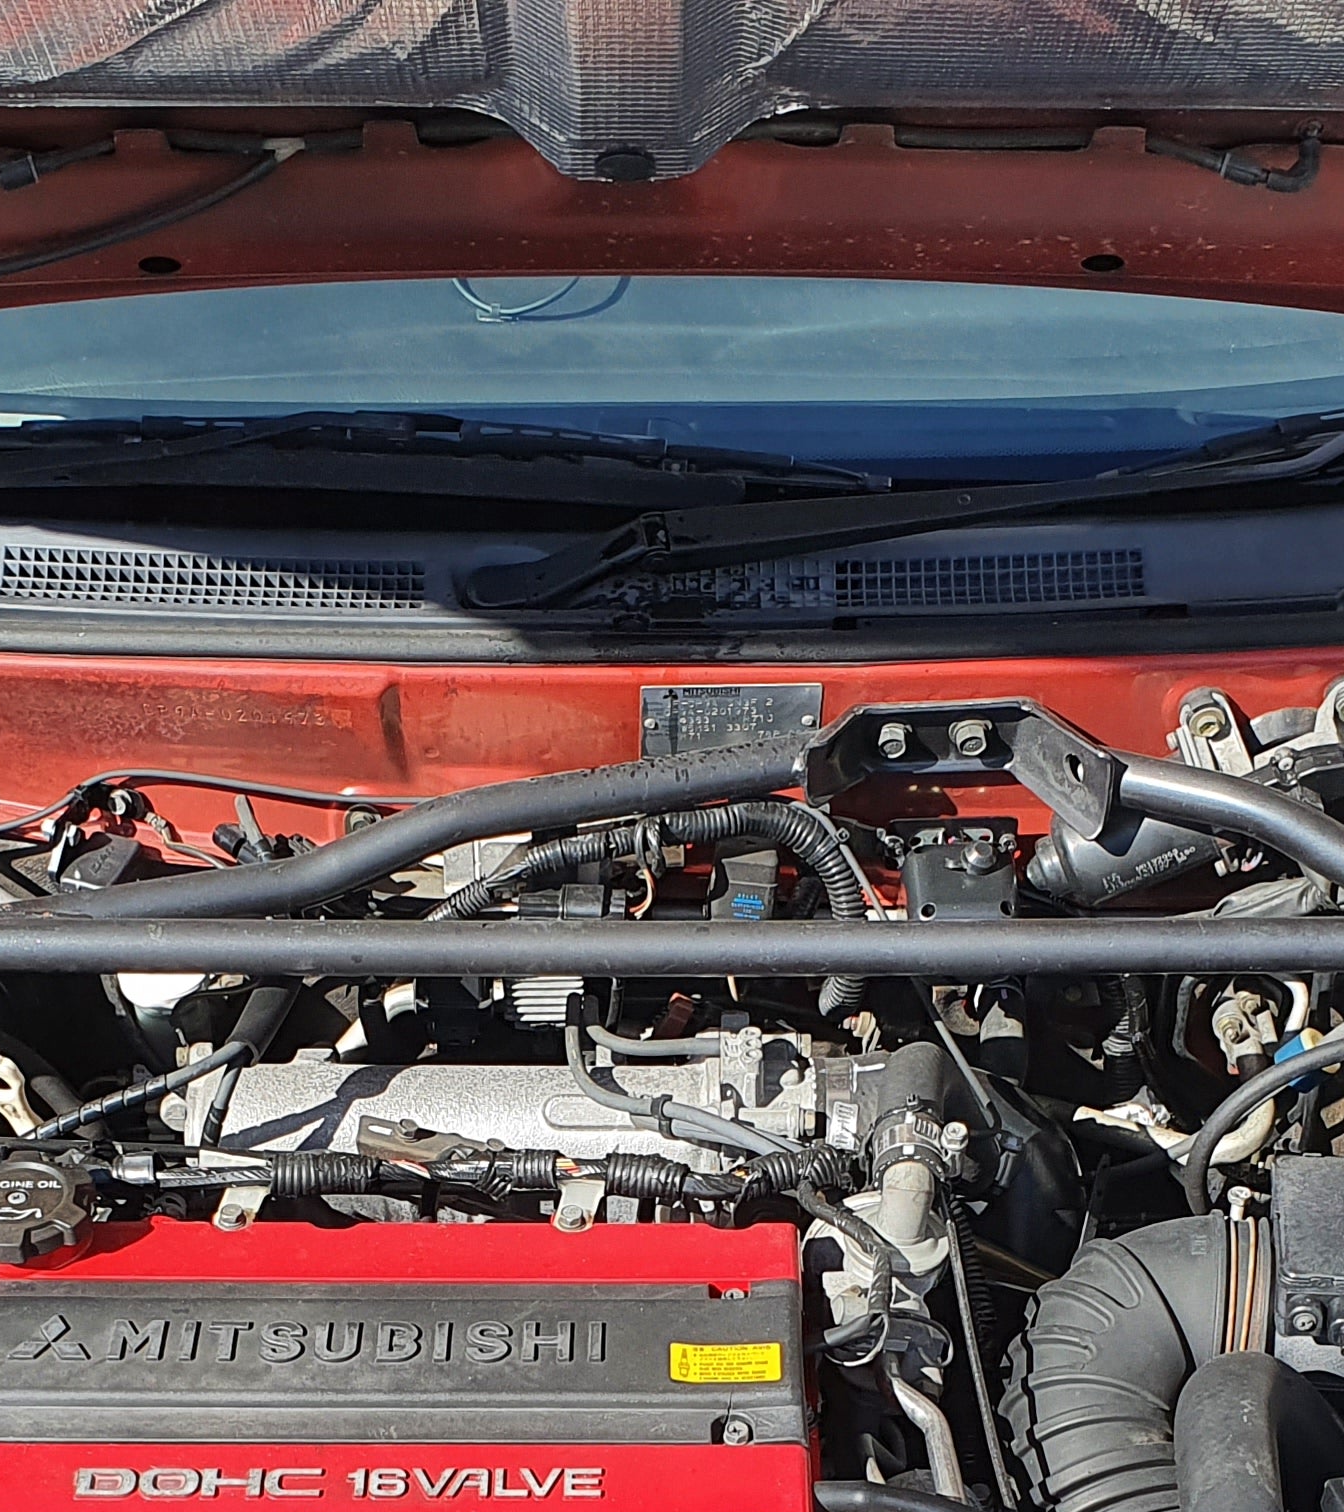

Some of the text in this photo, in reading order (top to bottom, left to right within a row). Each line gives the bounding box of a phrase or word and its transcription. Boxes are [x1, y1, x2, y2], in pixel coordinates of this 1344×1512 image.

[682, 687, 741, 697] MITSUBISHI
[37, 1180, 62, 1189] OIL
[106, 1315, 609, 1364] MITSUBISHI
[73, 1468, 326, 1502] DOHC
